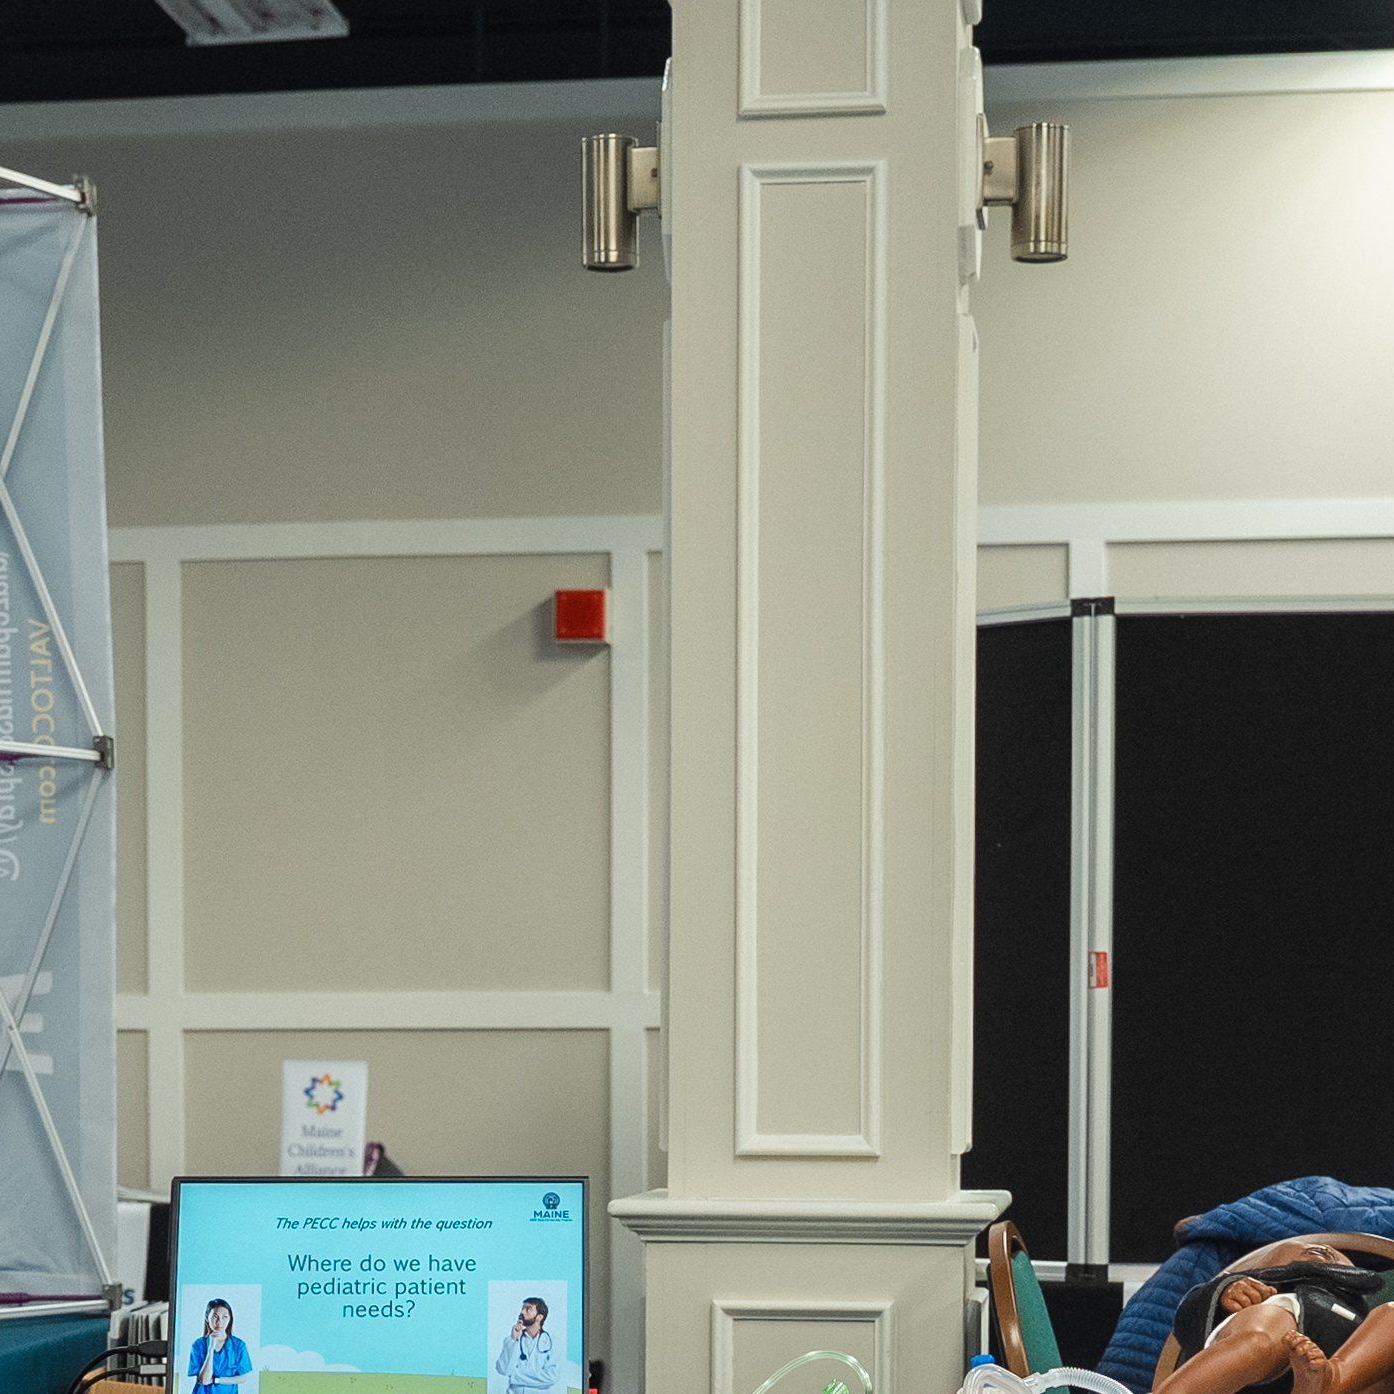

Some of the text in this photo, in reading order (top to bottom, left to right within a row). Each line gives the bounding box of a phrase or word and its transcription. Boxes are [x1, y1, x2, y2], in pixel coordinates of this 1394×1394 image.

[533, 1210, 570, 1219] MAINE
[276, 1217, 493, 1232] The PECC helps with the question
[287, 1253, 477, 1272] Where do we have
[297, 1277, 467, 1300] pediatric patient
[342, 1299, 416, 1318] needs?
